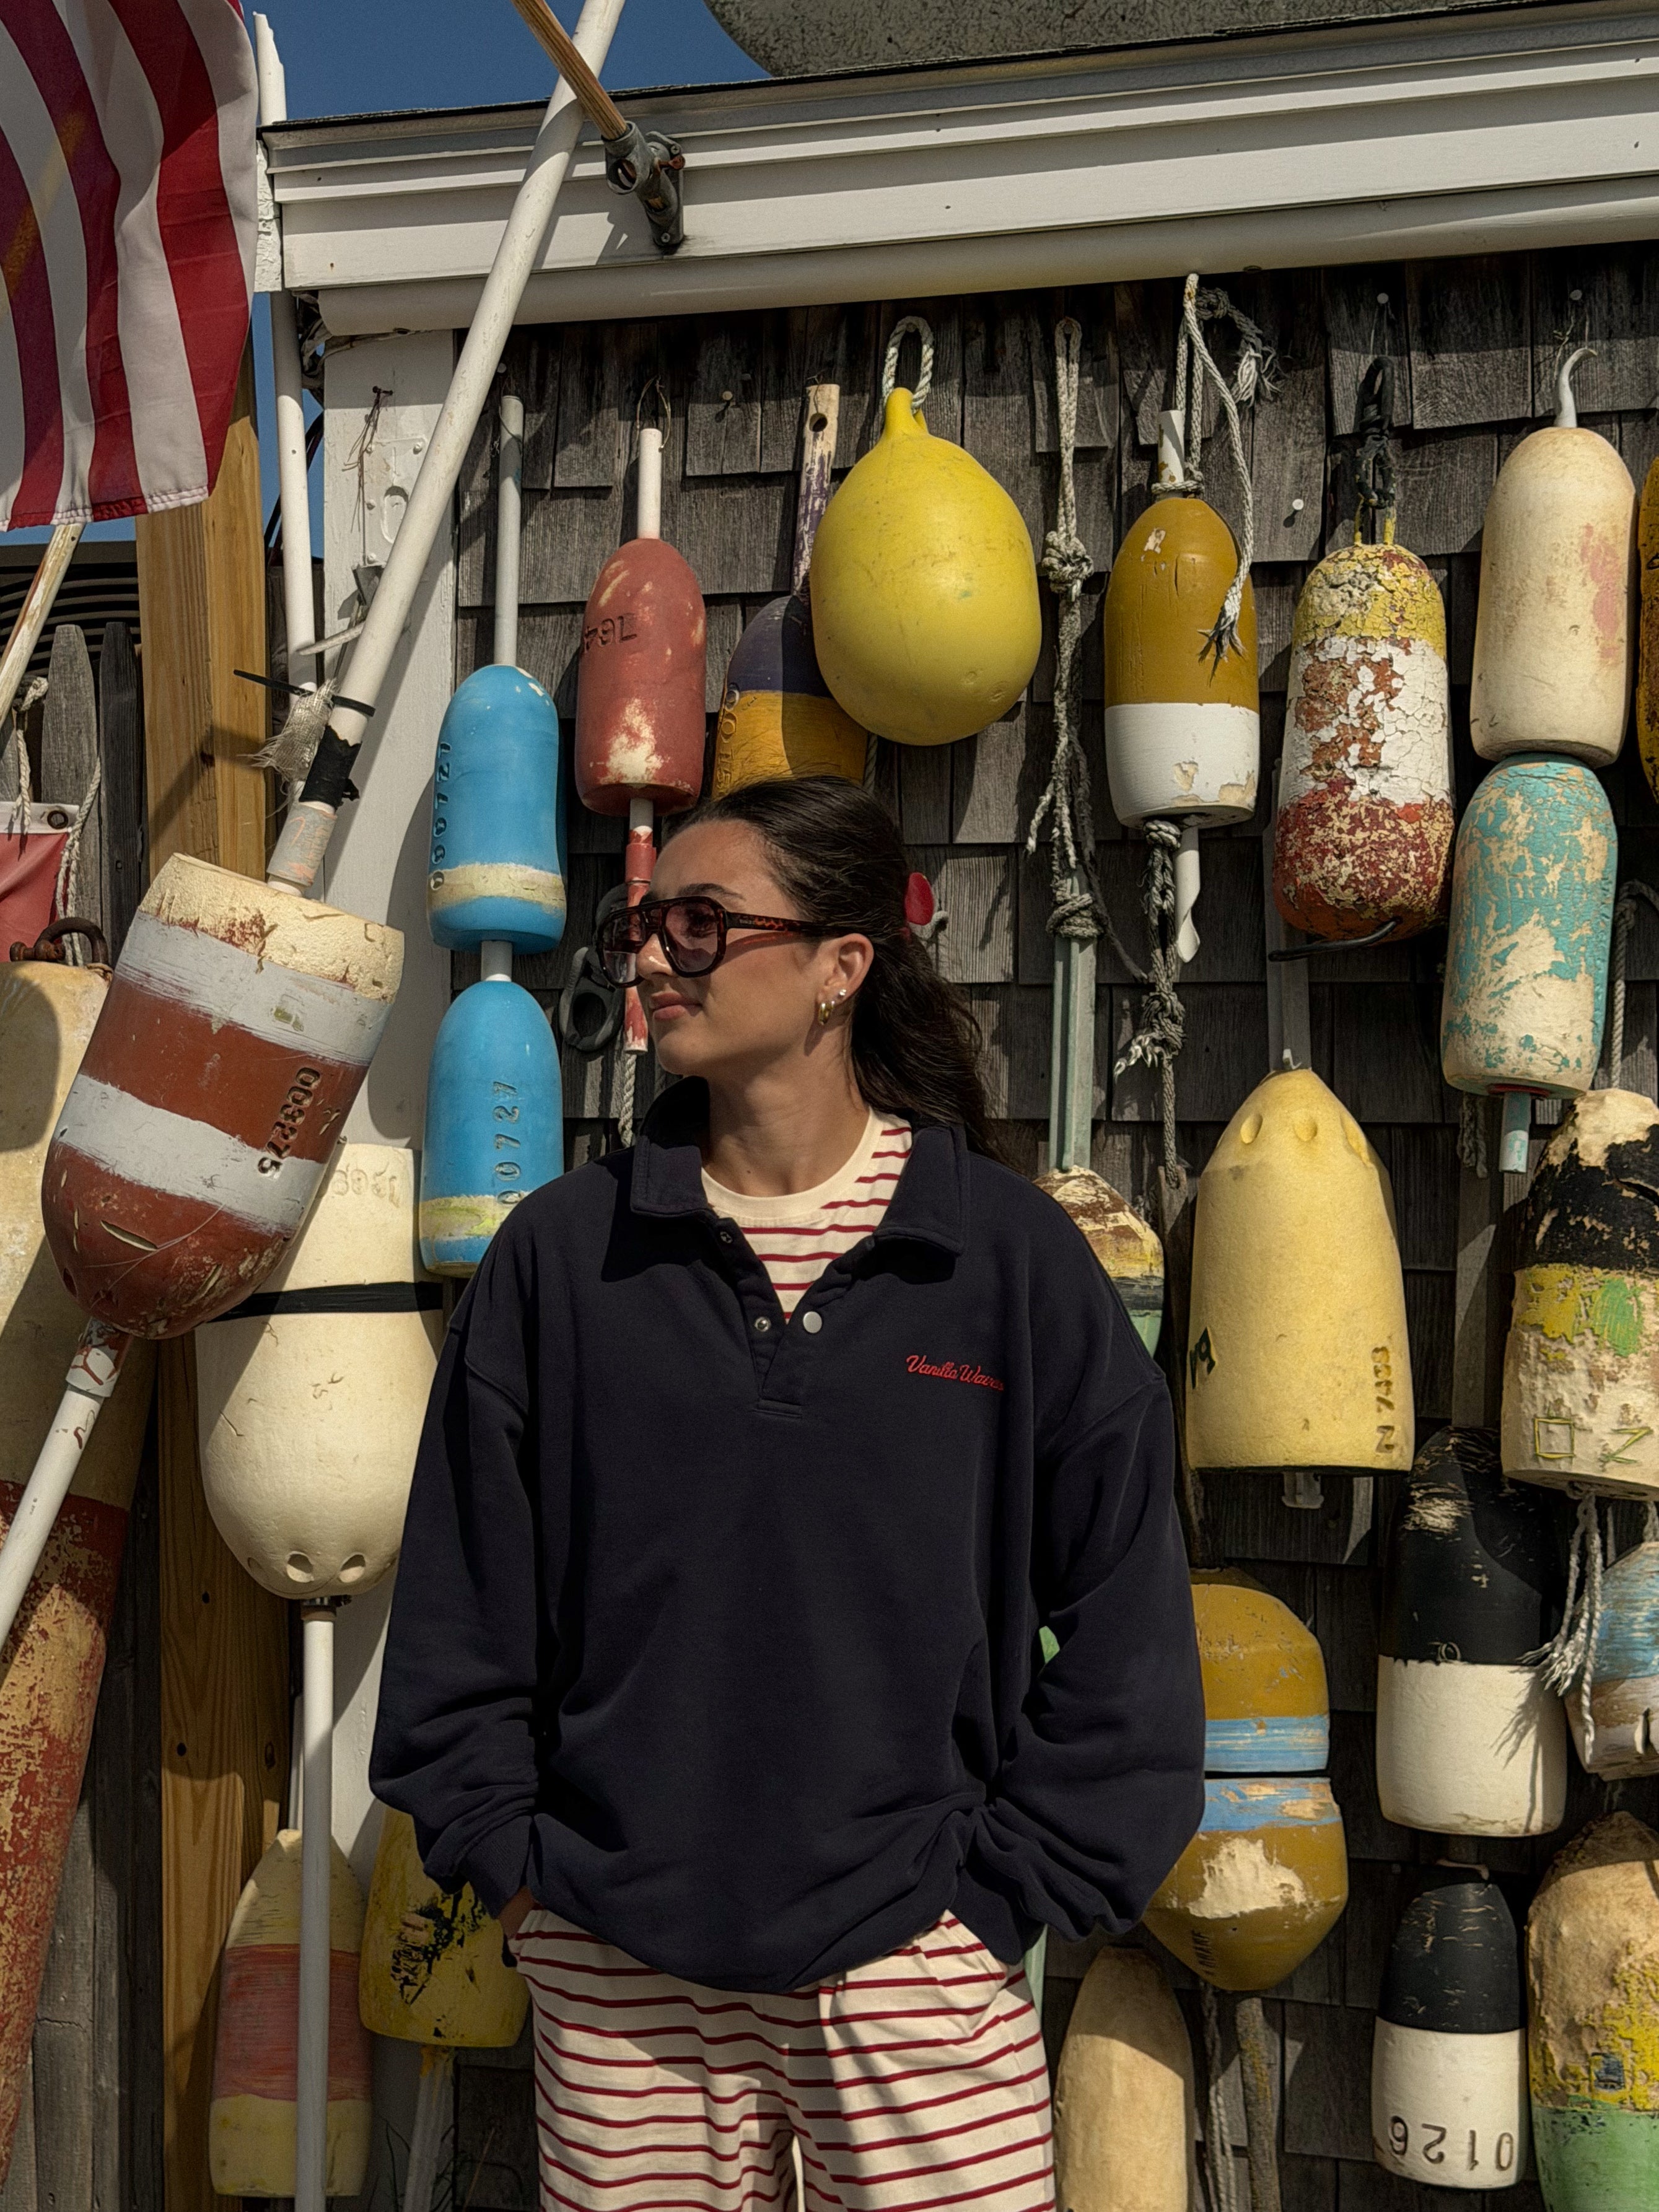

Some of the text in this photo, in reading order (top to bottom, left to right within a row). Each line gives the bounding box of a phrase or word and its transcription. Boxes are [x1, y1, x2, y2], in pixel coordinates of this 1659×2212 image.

[258, 1067, 322, 1178] 003275
[906, 1355, 958, 1379] Vanilla
[1389, 2116, 1513, 2172] 0126
